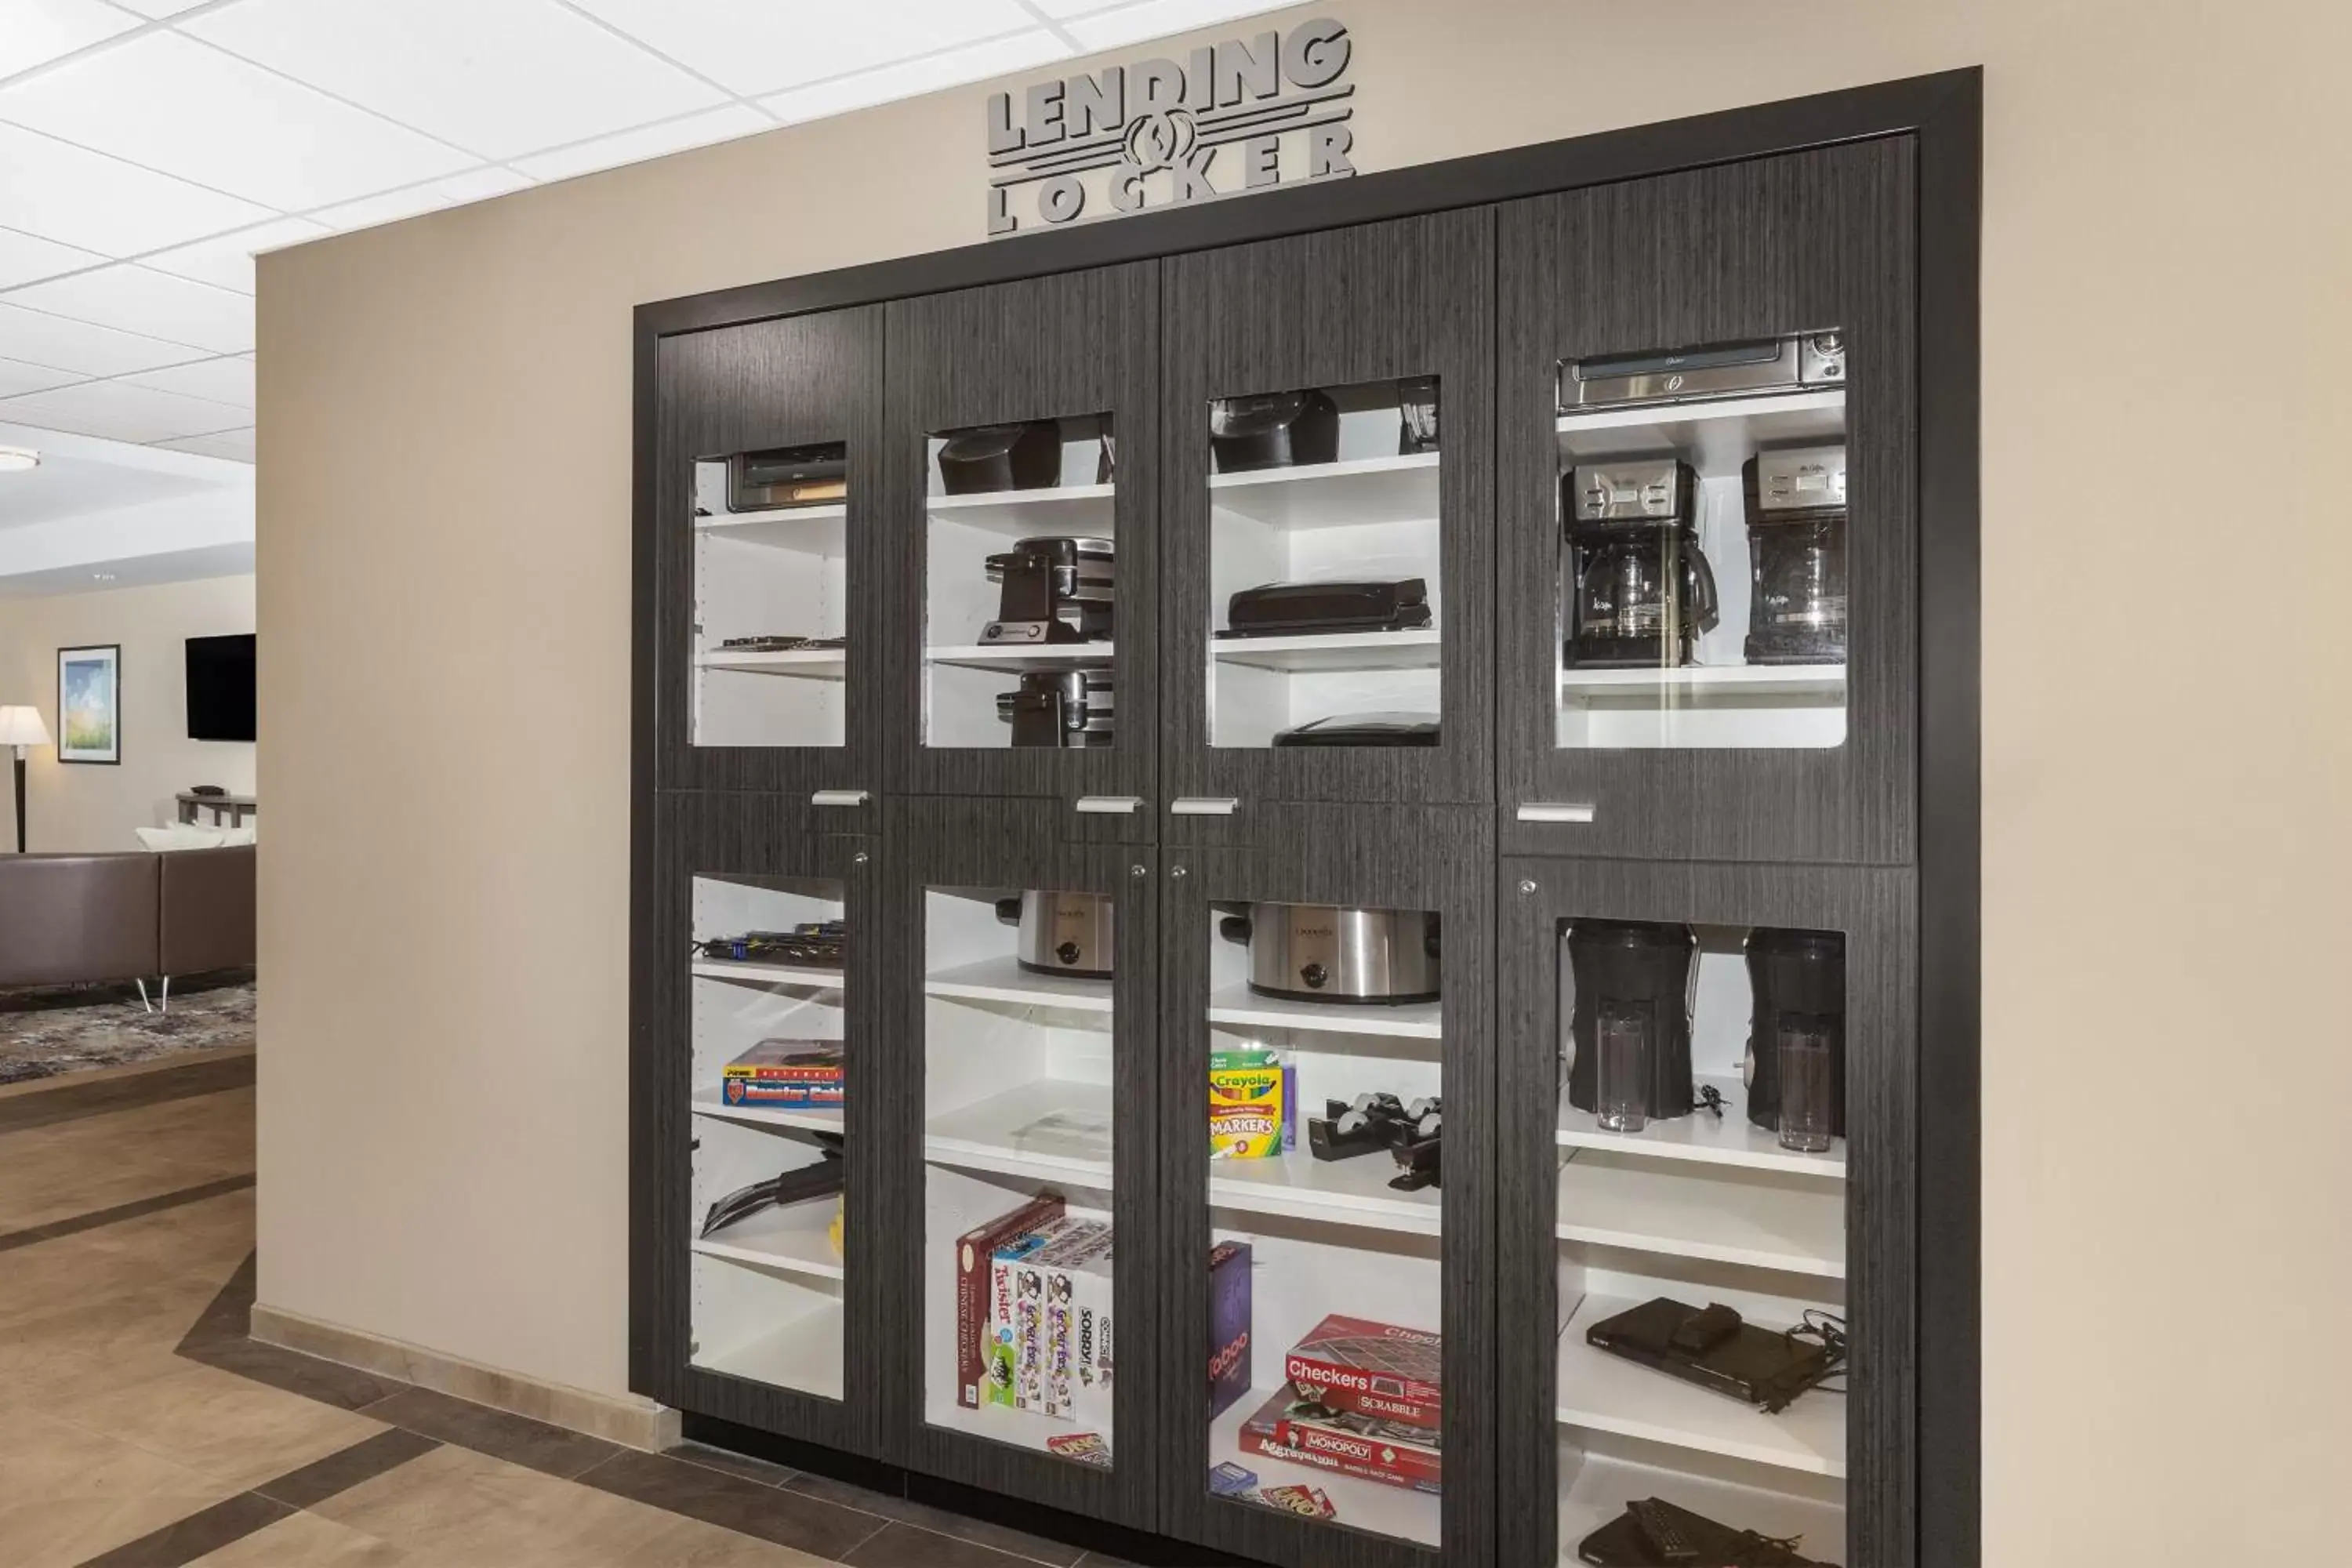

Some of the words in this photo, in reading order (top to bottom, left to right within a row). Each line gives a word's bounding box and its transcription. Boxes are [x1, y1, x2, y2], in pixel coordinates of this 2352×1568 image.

[988, 17, 1352, 155] LENDING
[988, 122, 1356, 235] LOCKER
[1216, 1073, 1271, 1088] Crayola
[1210, 1118, 1274, 1135] MARKERS
[994, 1265, 1011, 1325] Twister
[1080, 1308, 1093, 1366] SORRY!
[1288, 1360, 1369, 1391] Checkers
[1360, 1396, 1421, 1417] SCRABBLE
[1308, 1435, 1369, 1457] MONOPOLY
